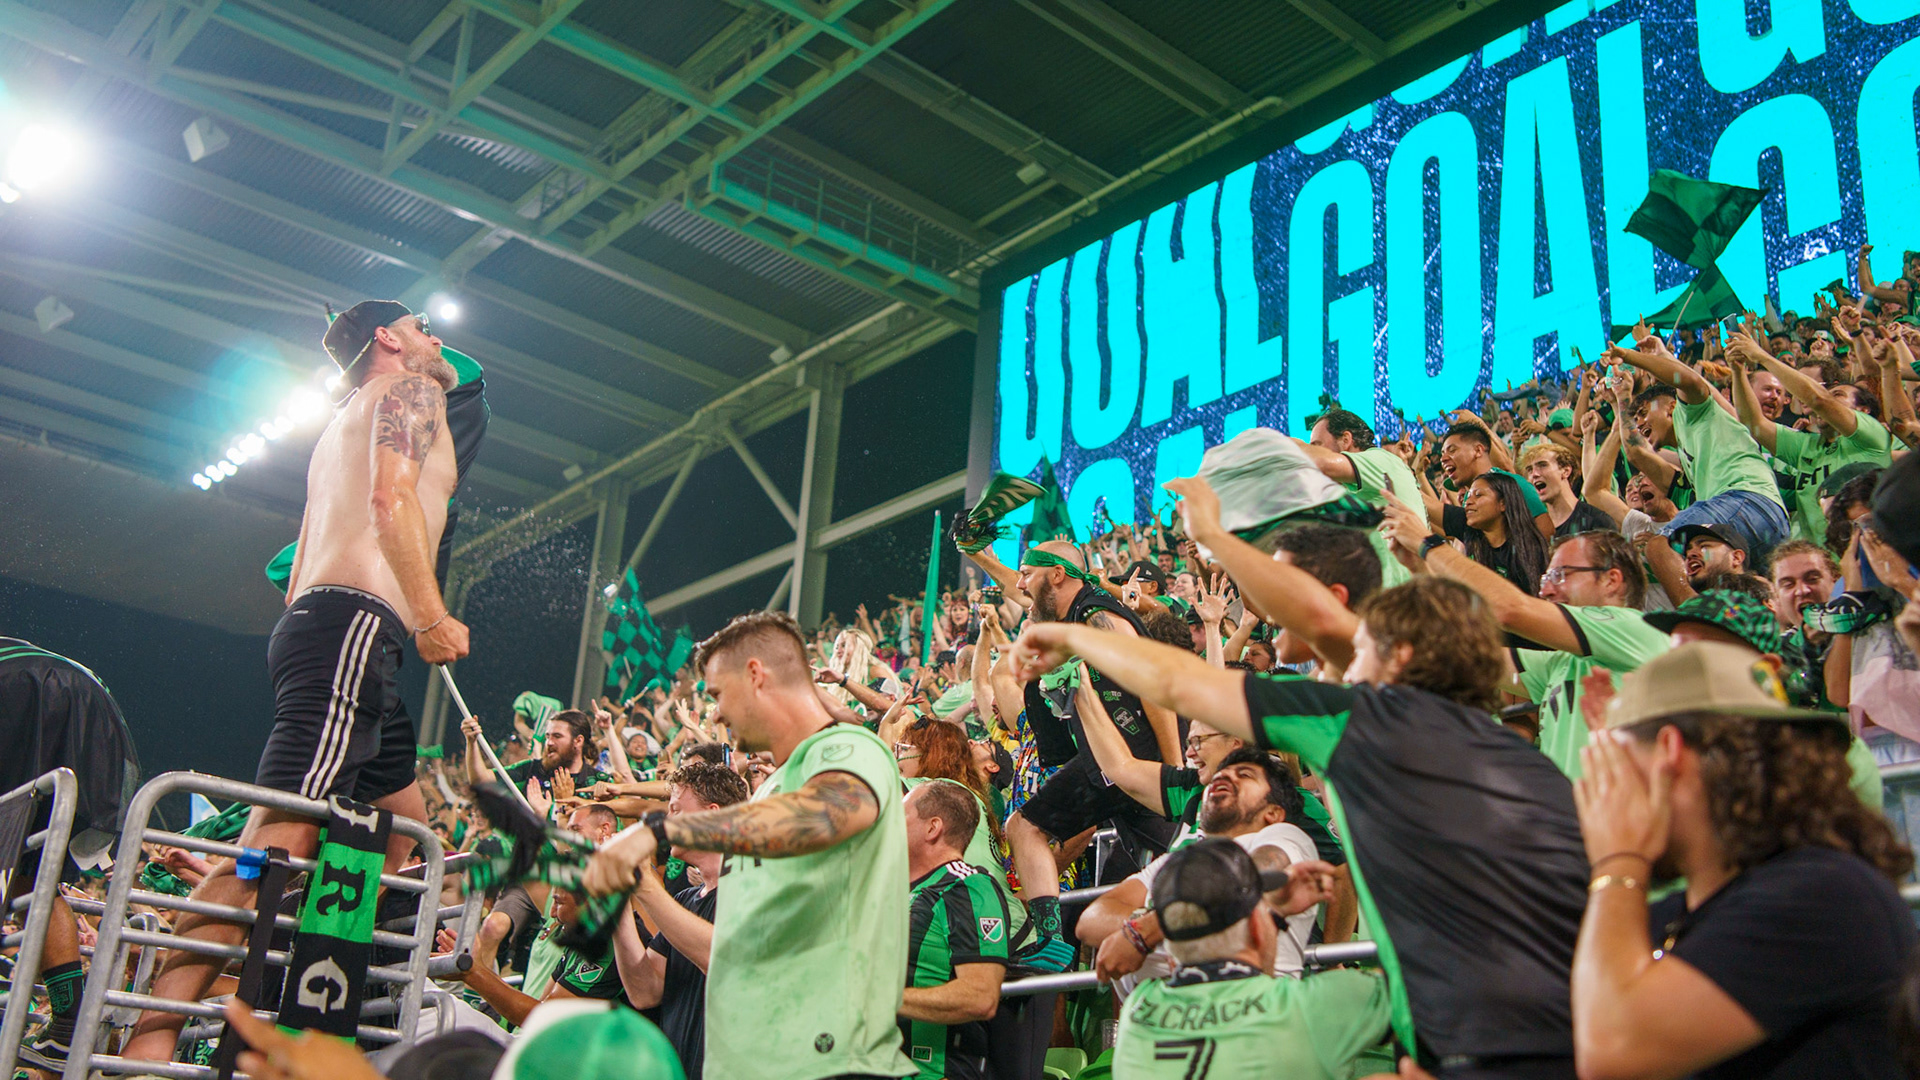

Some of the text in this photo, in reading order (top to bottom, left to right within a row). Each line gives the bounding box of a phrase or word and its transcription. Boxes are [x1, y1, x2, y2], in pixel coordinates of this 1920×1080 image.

[1288, 20, 1695, 443] GOAL
[1160, 994, 1267, 1030] CRACK
[1154, 1037, 1217, 1080] 7
